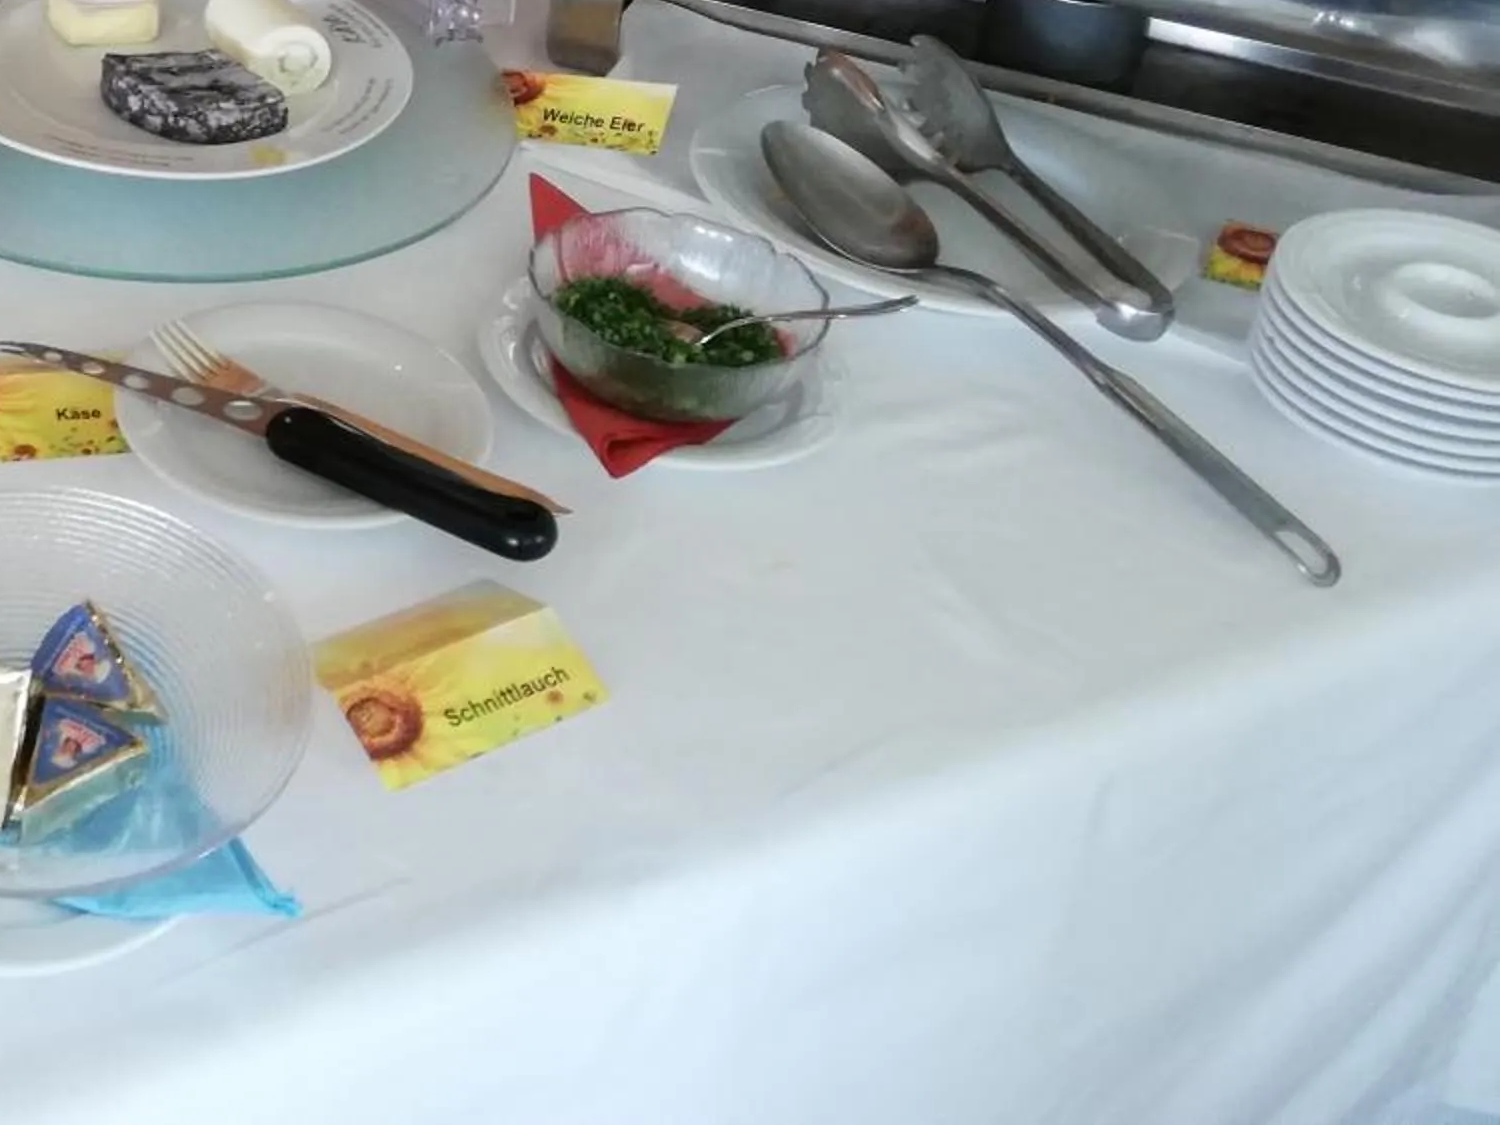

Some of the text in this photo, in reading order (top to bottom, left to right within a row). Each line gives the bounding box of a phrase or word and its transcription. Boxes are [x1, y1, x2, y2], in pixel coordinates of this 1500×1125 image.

[543, 107, 646, 133] Weiche Eier
[443, 666, 571, 727] Schnittlauch
